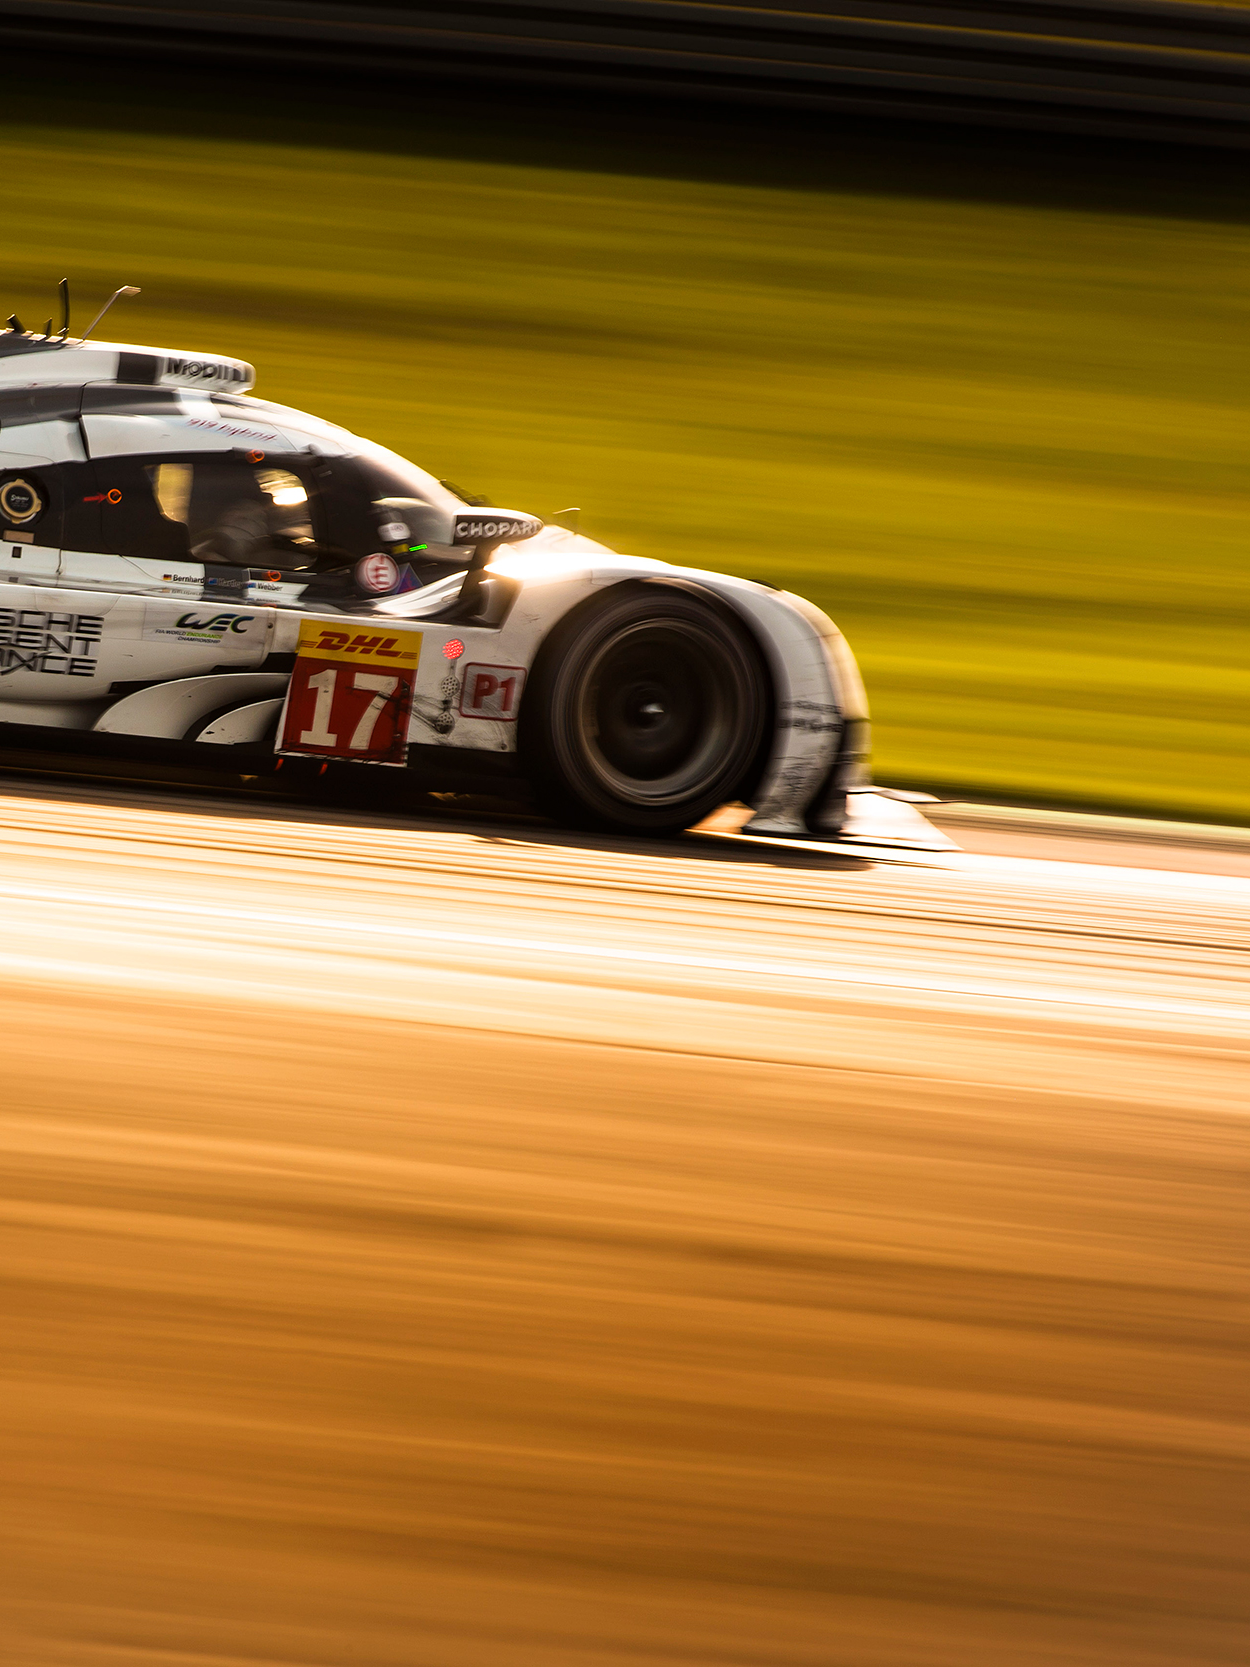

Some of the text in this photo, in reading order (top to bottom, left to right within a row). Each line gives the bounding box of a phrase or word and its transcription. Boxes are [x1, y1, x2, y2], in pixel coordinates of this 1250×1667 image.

[456, 521, 542, 537] CHOPARD
[173, 574, 205, 584] Bernhard
[257, 583, 283, 592] Webber
[175, 612, 255, 633] WEC
[177, 636, 221, 644] CHAMPIONSHIP
[186, 631, 223, 639] ENDURANCE
[315, 630, 406, 659] DHL
[473, 672, 516, 712] P1
[299, 668, 399, 751] 17
